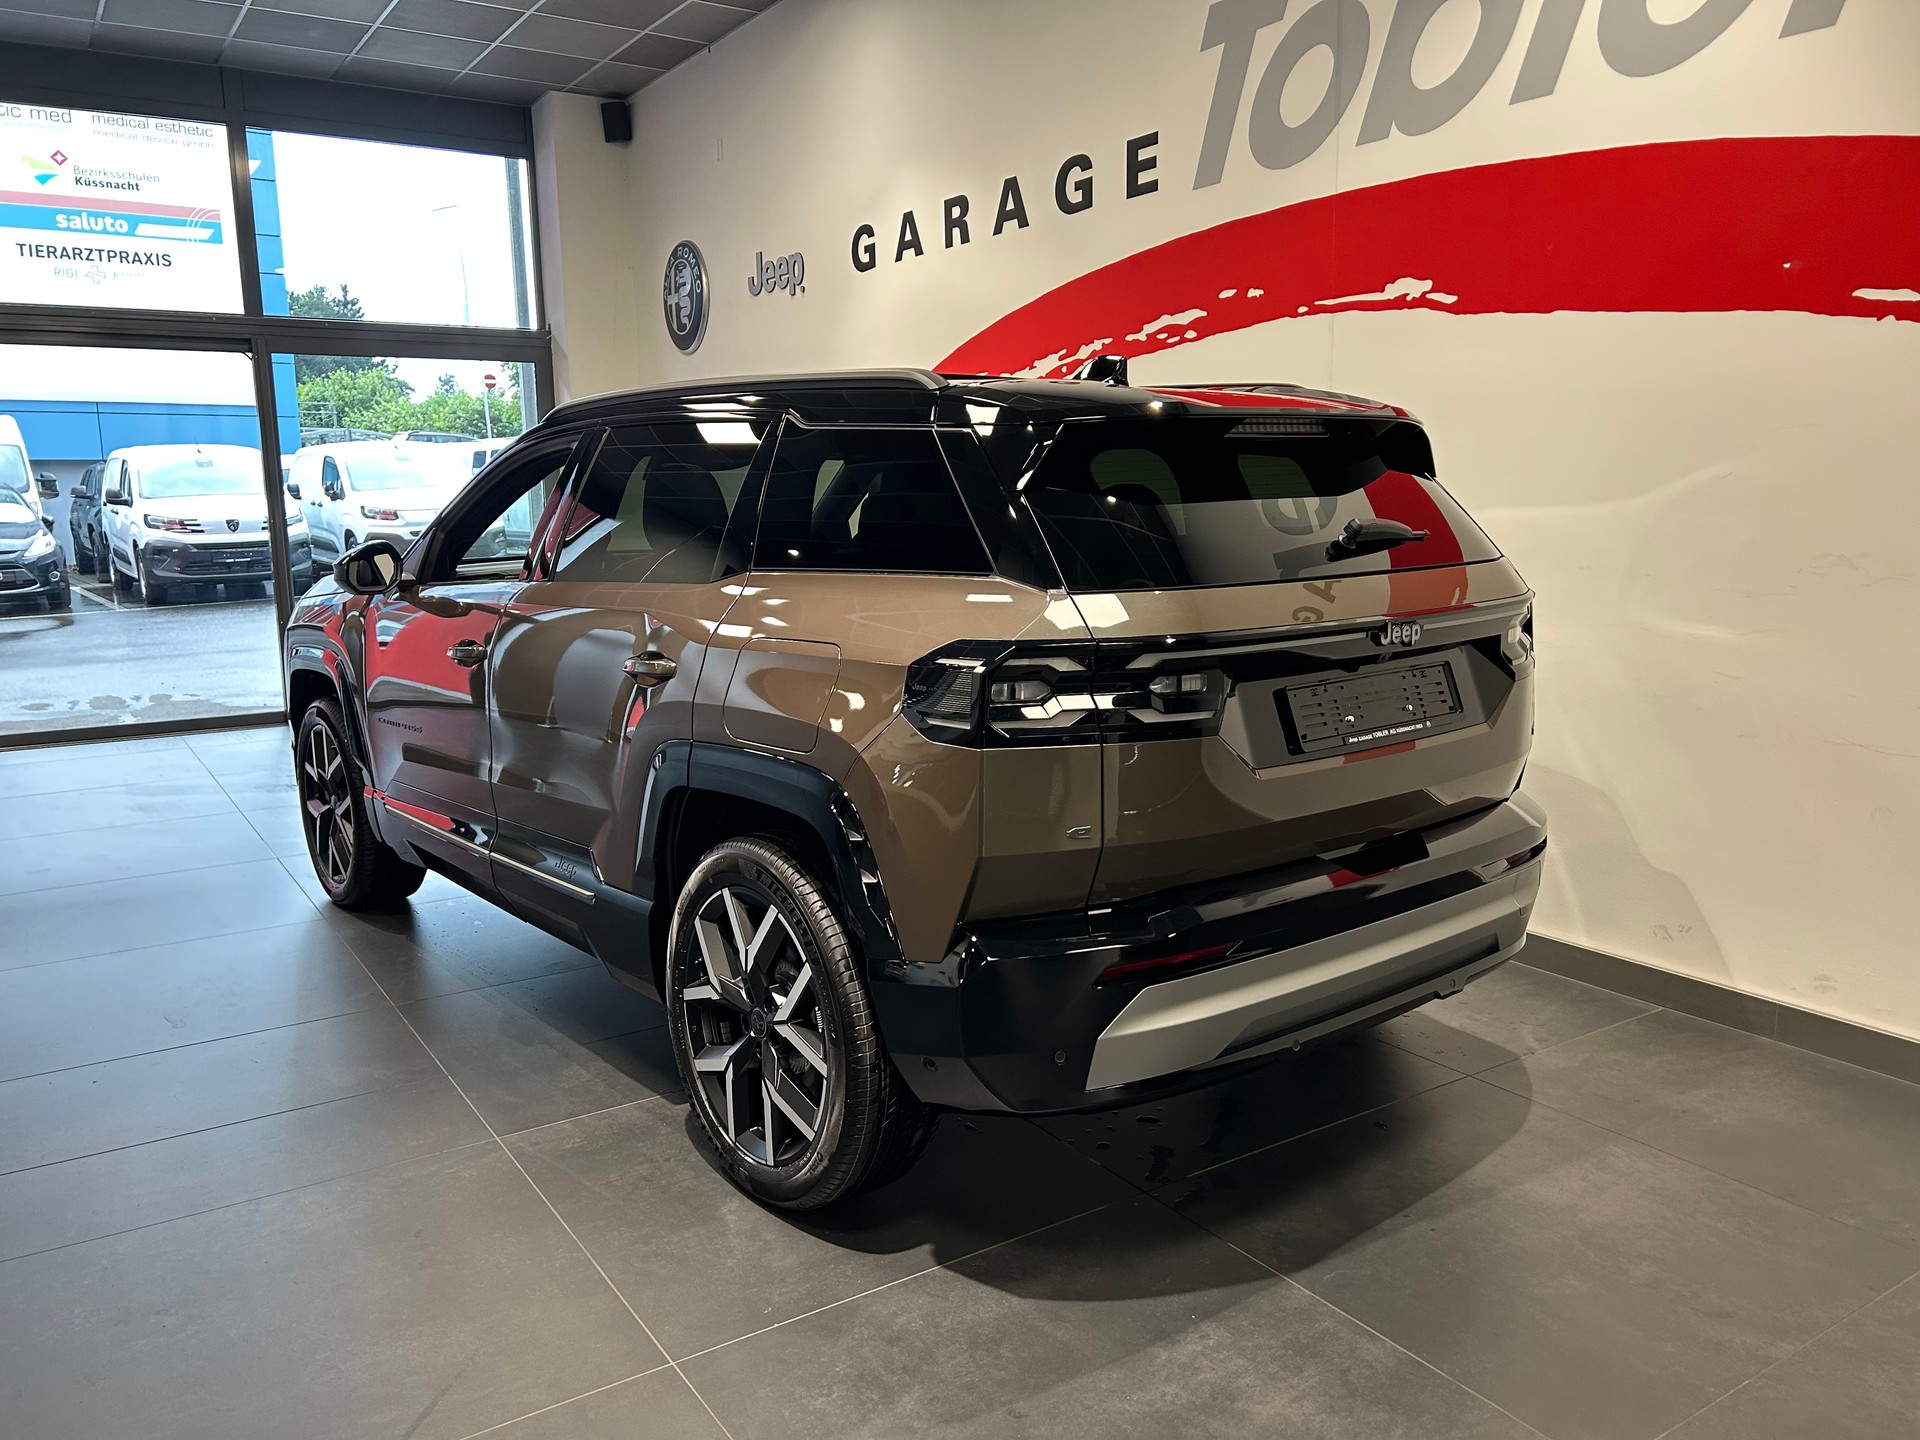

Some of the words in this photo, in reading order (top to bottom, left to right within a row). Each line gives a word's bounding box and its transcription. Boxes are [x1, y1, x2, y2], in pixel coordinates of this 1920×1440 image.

[30, 108, 72, 123] med
[92, 114, 150, 130] medical
[155, 121, 214, 138] esthetic
[93, 129, 138, 140] medical
[73, 165, 160, 183] Bezirksschulen
[75, 176, 140, 191] Küssnacht
[851, 130, 1159, 273] GARAGE
[56, 211, 129, 233] saluto
[16, 243, 172, 267] TIERARZTPRAXIS
[53, 267, 78, 279] RIGI
[677, 246, 702, 293] ROMEO
[747, 251, 805, 297] Jeep
[1380, 620, 1421, 646] Jeep
